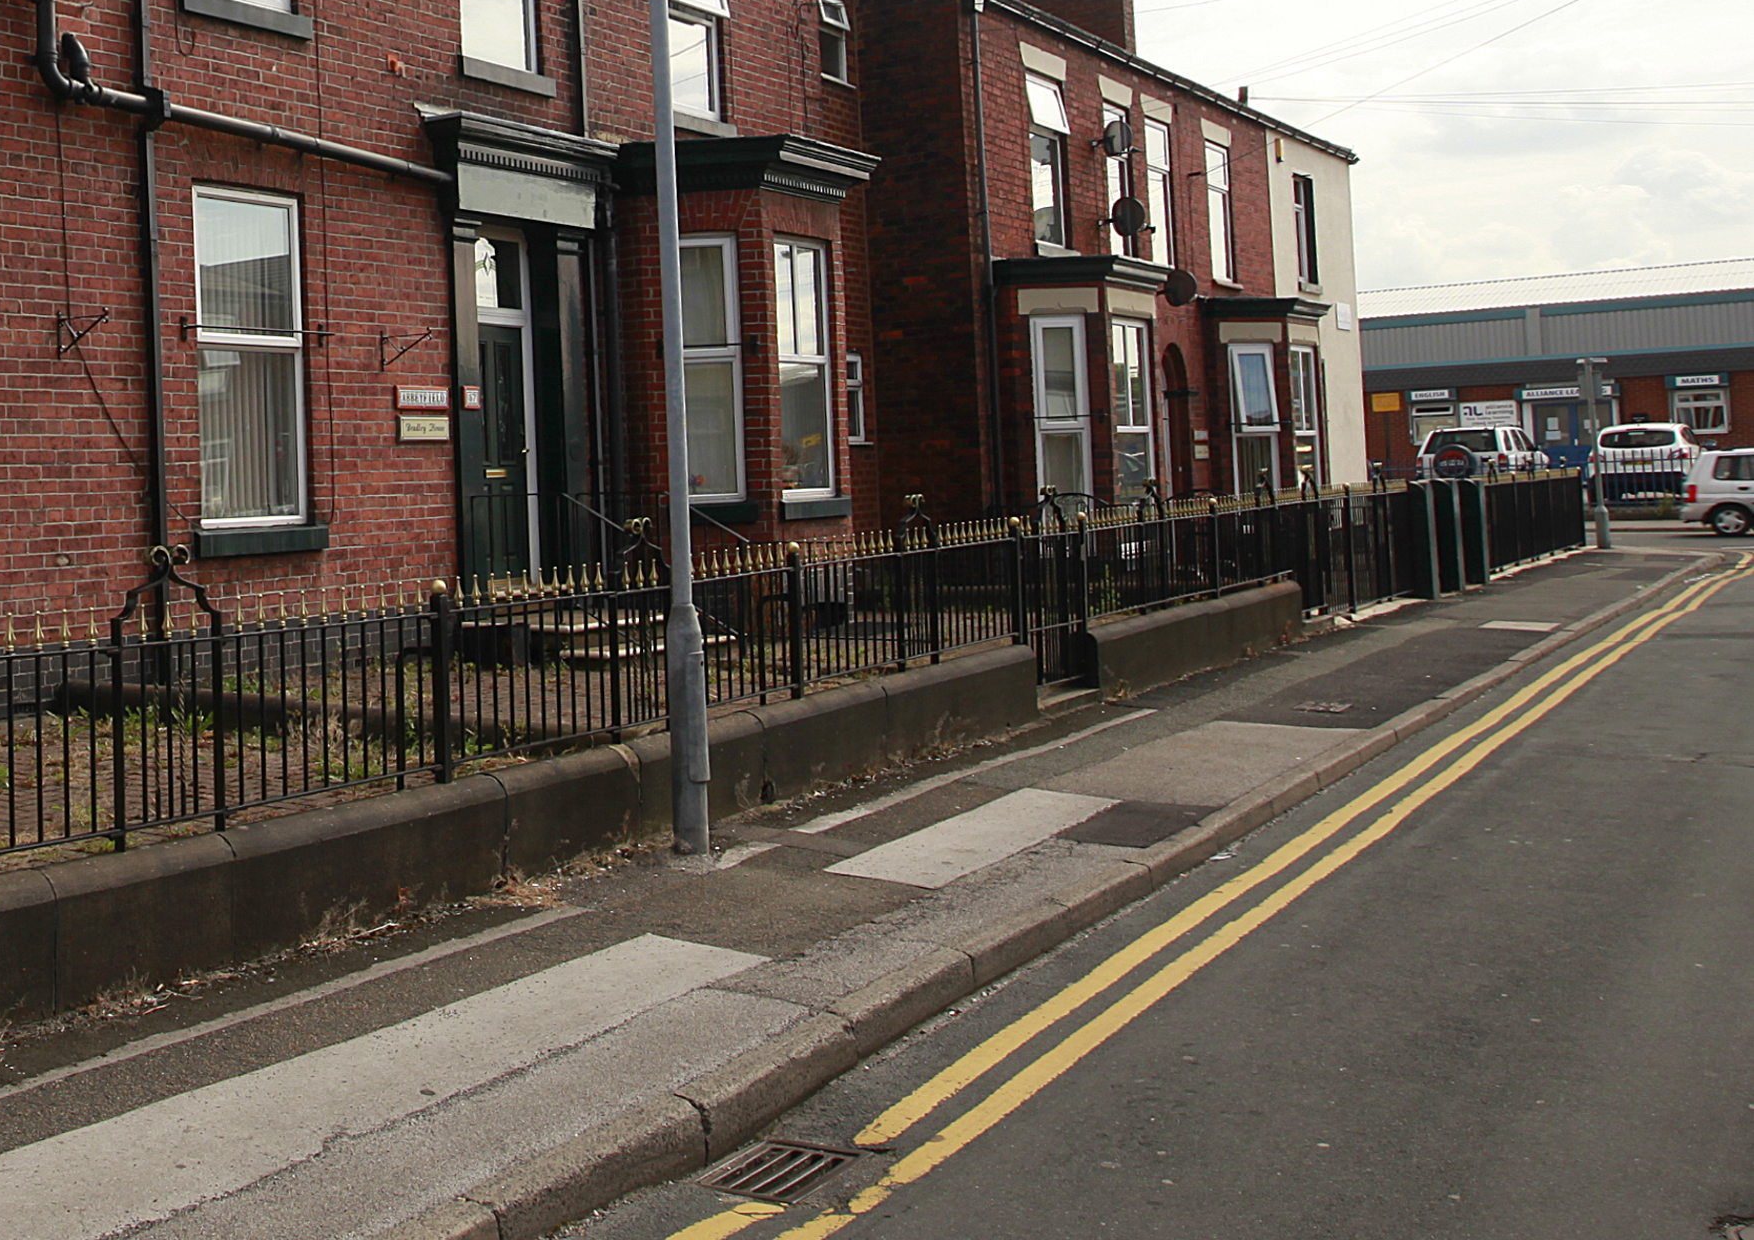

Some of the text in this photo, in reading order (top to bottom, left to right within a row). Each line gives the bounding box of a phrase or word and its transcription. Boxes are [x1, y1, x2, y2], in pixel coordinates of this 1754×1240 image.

[1680, 376, 1715, 385] MATHS
[1414, 390, 1446, 399] ENGLISH
[1525, 388, 1564, 398] ALLIANCE
